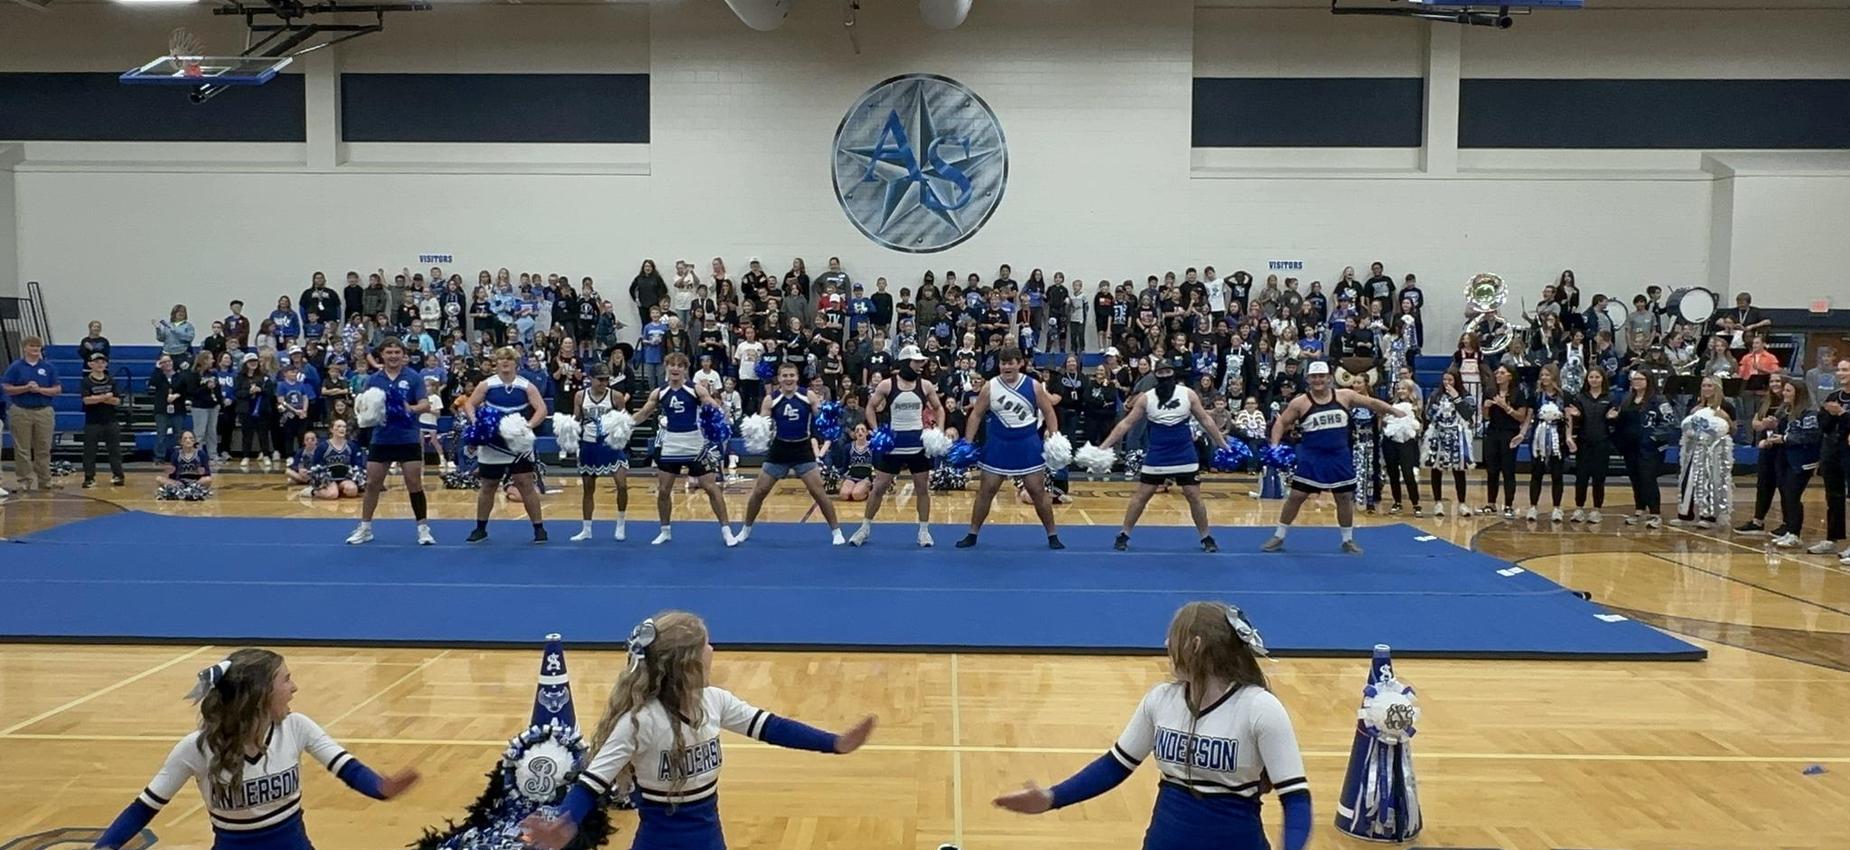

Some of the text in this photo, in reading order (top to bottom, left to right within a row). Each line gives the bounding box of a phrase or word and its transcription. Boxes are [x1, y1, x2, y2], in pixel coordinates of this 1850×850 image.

[419, 255, 453, 263] VISITORS
[1269, 261, 1303, 269] VISITORS
[669, 395, 685, 413] AS
[783, 403, 800, 420] AS
[1312, 413, 1342, 427] ASHS
[1155, 726, 1239, 773] NDERSON
